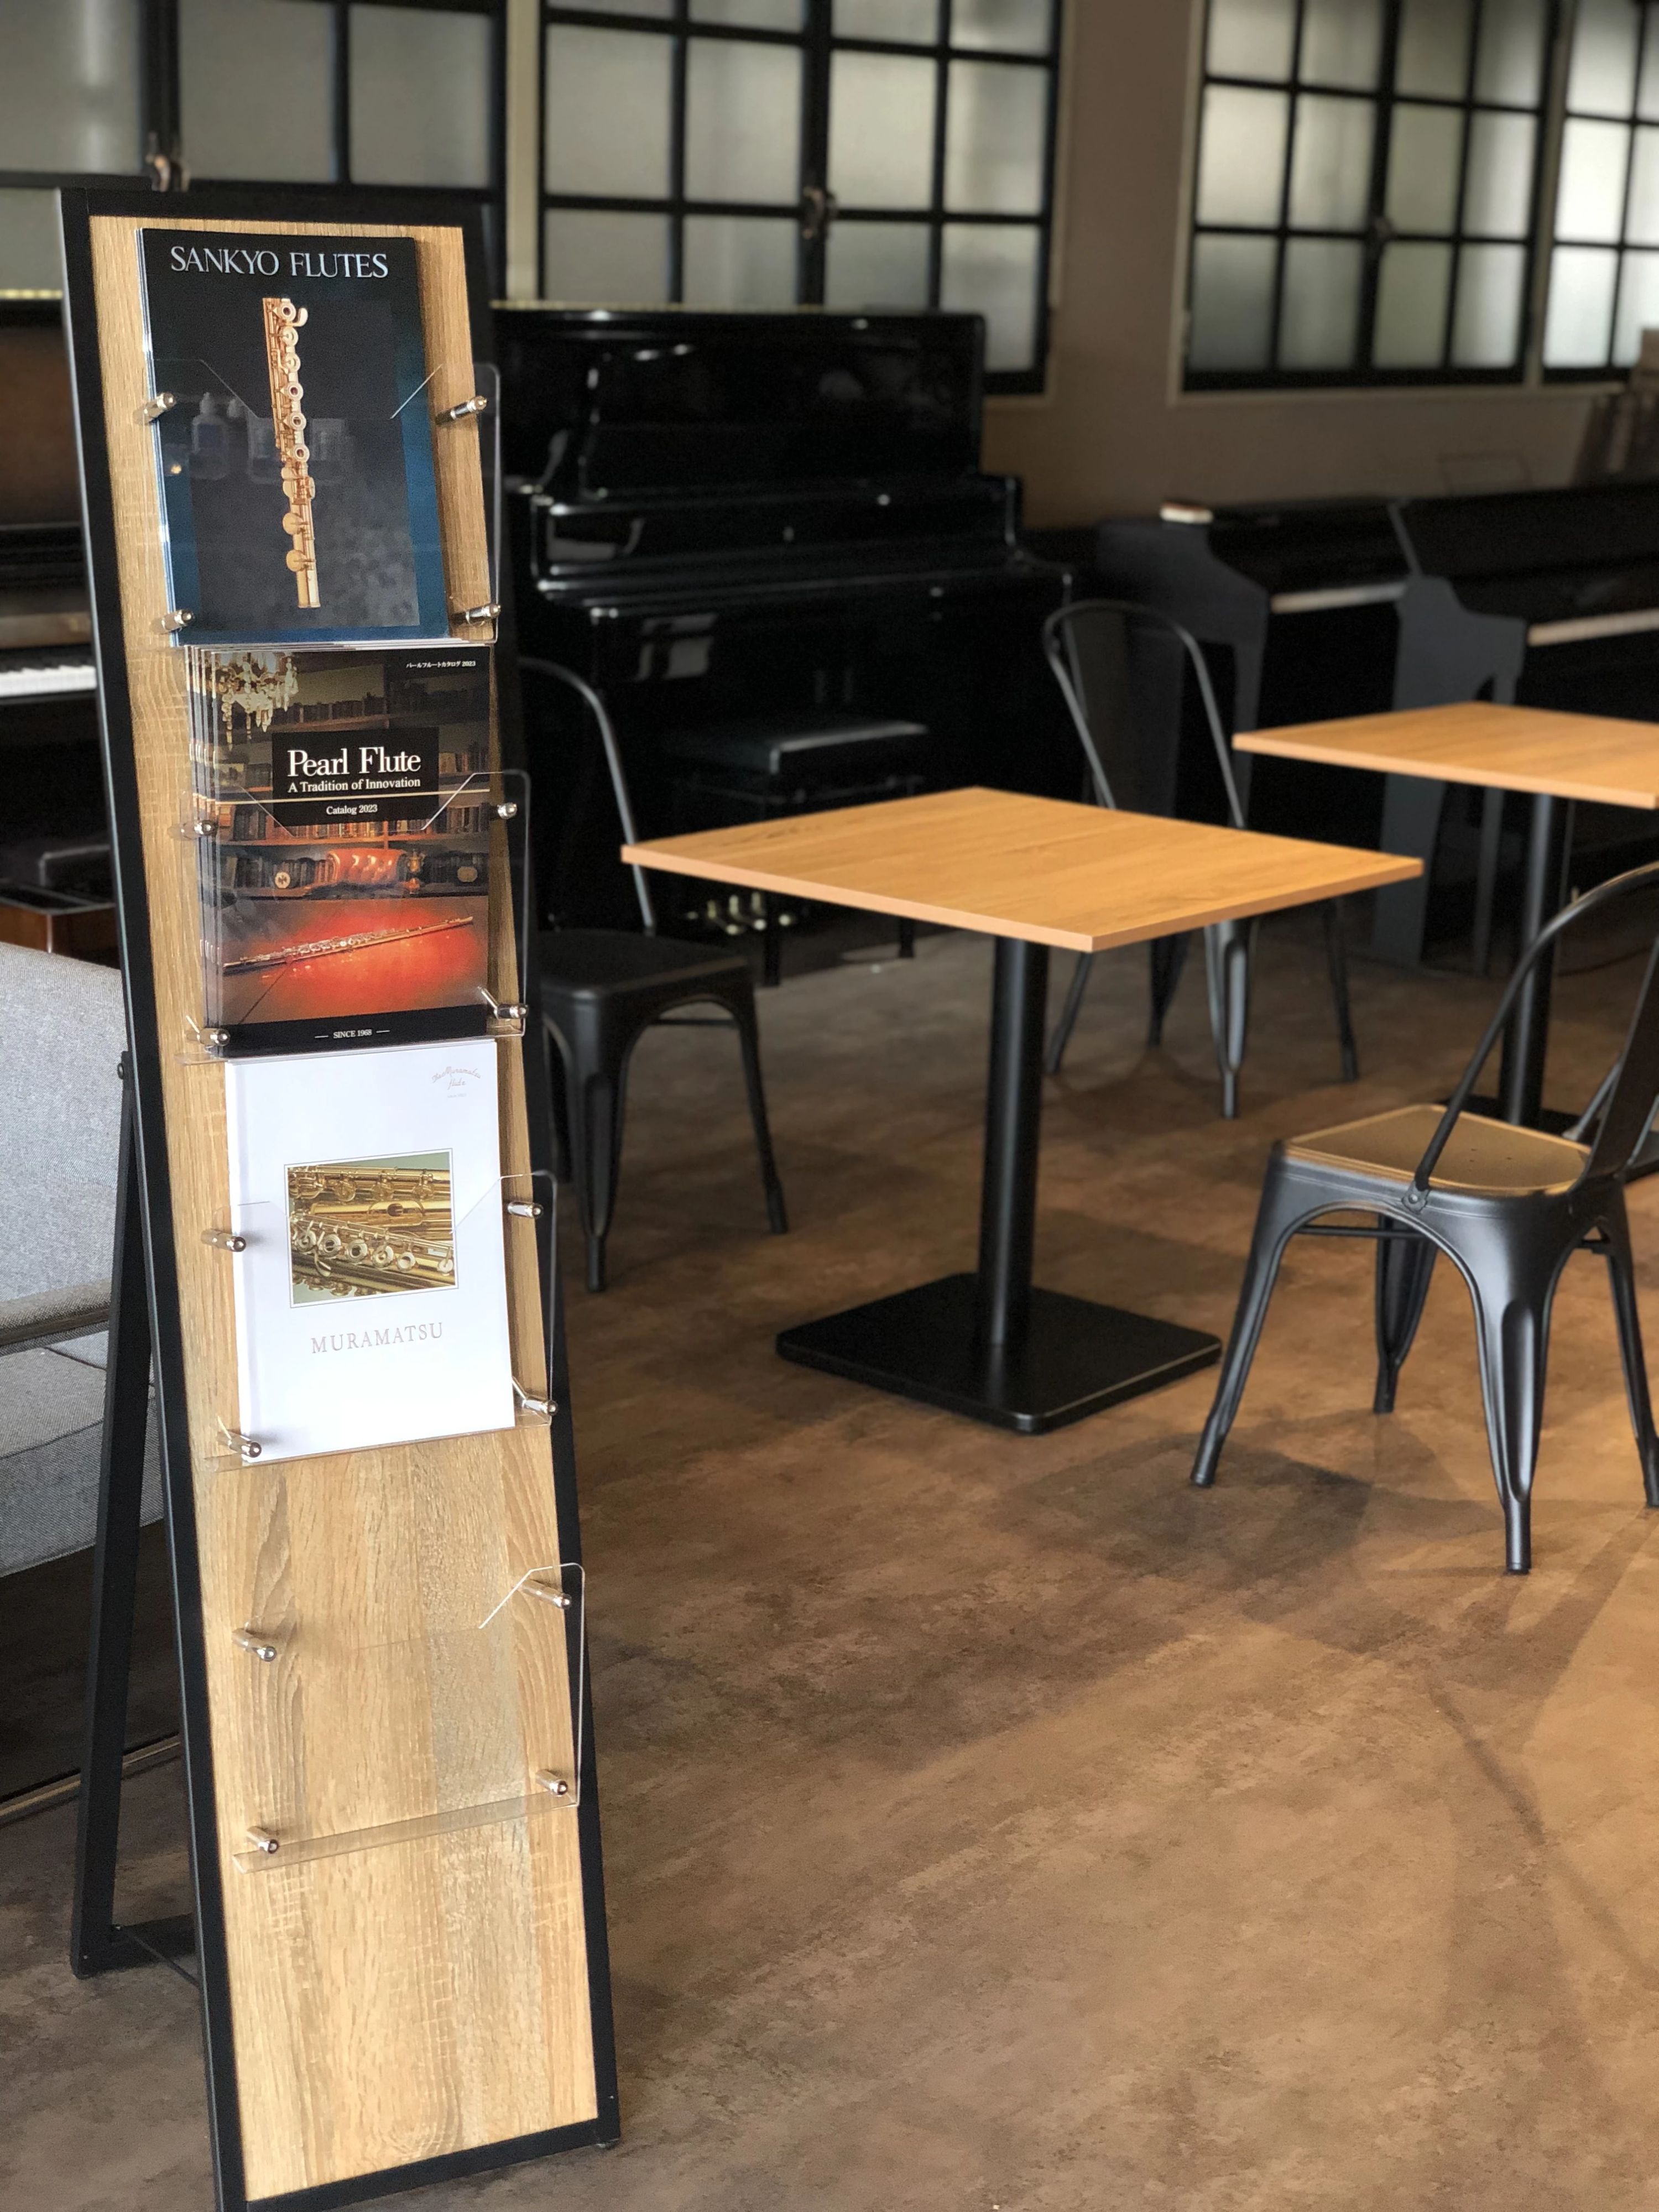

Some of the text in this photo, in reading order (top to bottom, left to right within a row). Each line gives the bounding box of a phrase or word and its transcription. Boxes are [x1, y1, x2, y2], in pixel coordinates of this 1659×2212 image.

[171, 246, 388, 278] SANKYO FLUTES
[287, 746, 421, 777] Pearl Flute
[288, 776, 421, 792] A Tradition of Innovation
[326, 804, 378, 815] Catalog 2023
[333, 1029, 372, 1039] SINCE 1968
[311, 1322, 442, 1354] MURAMATSU
